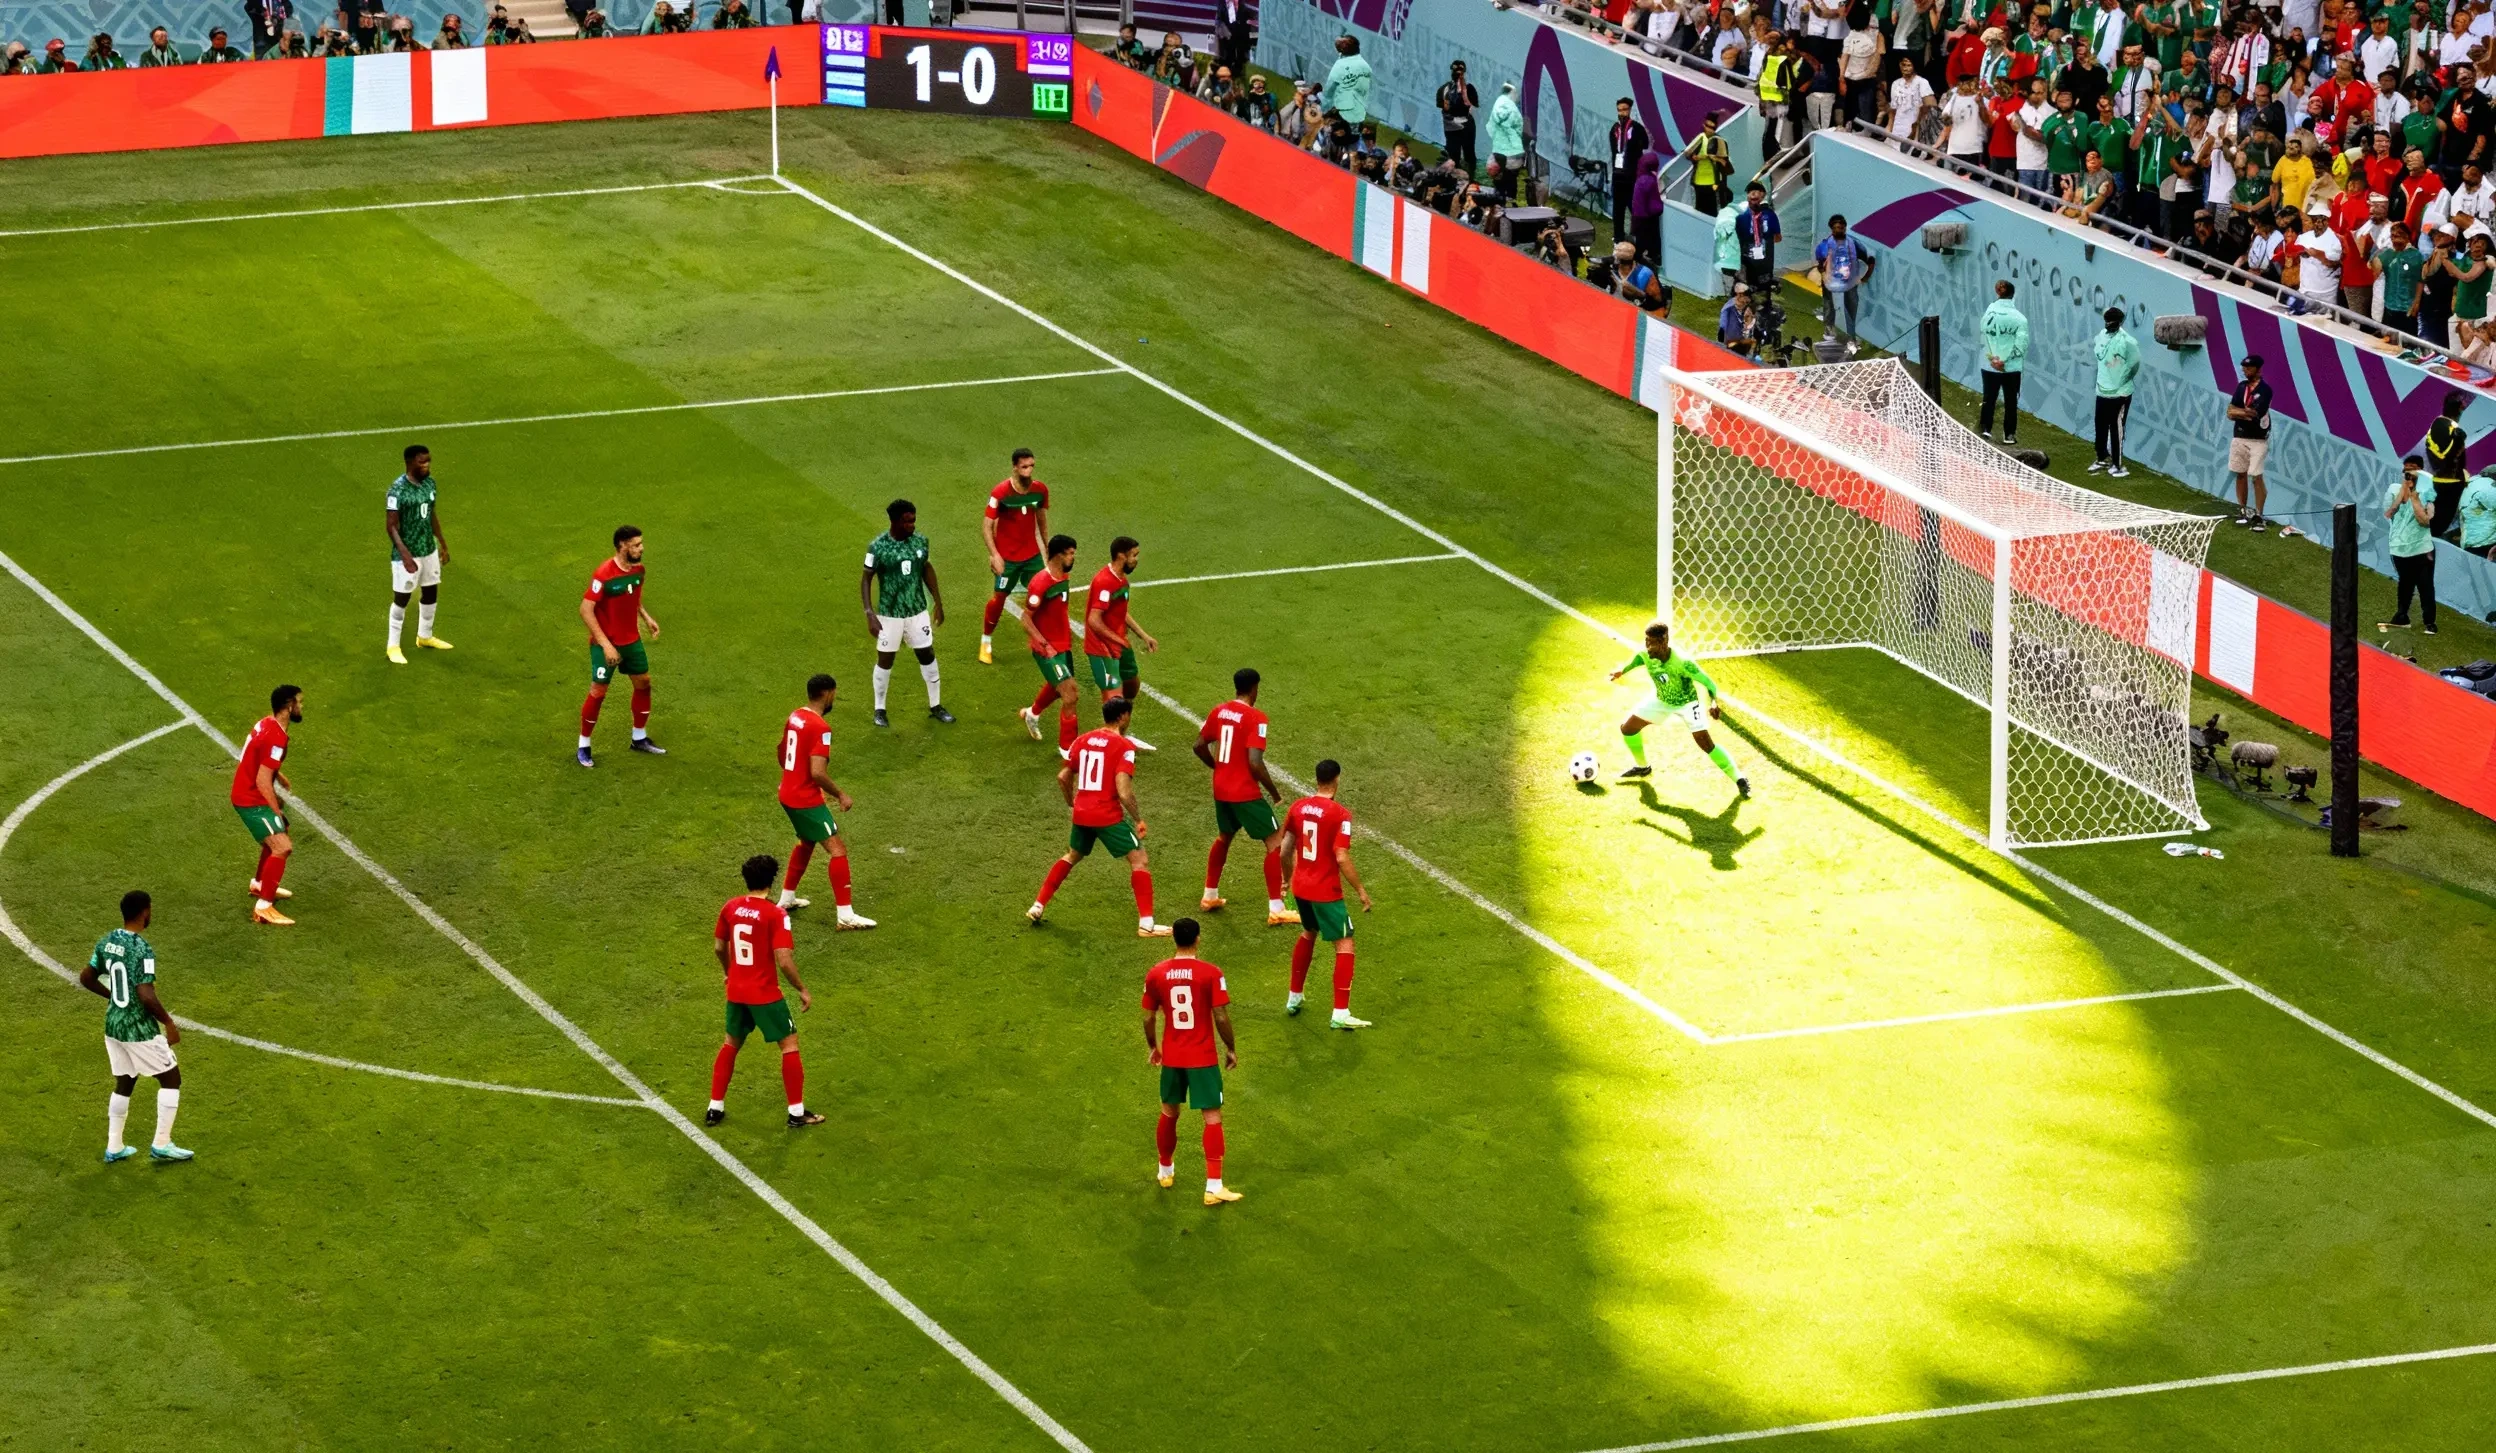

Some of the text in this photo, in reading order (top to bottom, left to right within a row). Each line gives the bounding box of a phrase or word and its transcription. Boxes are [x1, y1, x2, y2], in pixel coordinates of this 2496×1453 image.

[906, 44, 996, 105] 1-0
[1218, 725, 1234, 764] 11
[1078, 749, 1105, 791] 10
[1302, 820, 1318, 862] 3
[733, 923, 754, 966] 6
[1170, 985, 1195, 1030] 8
